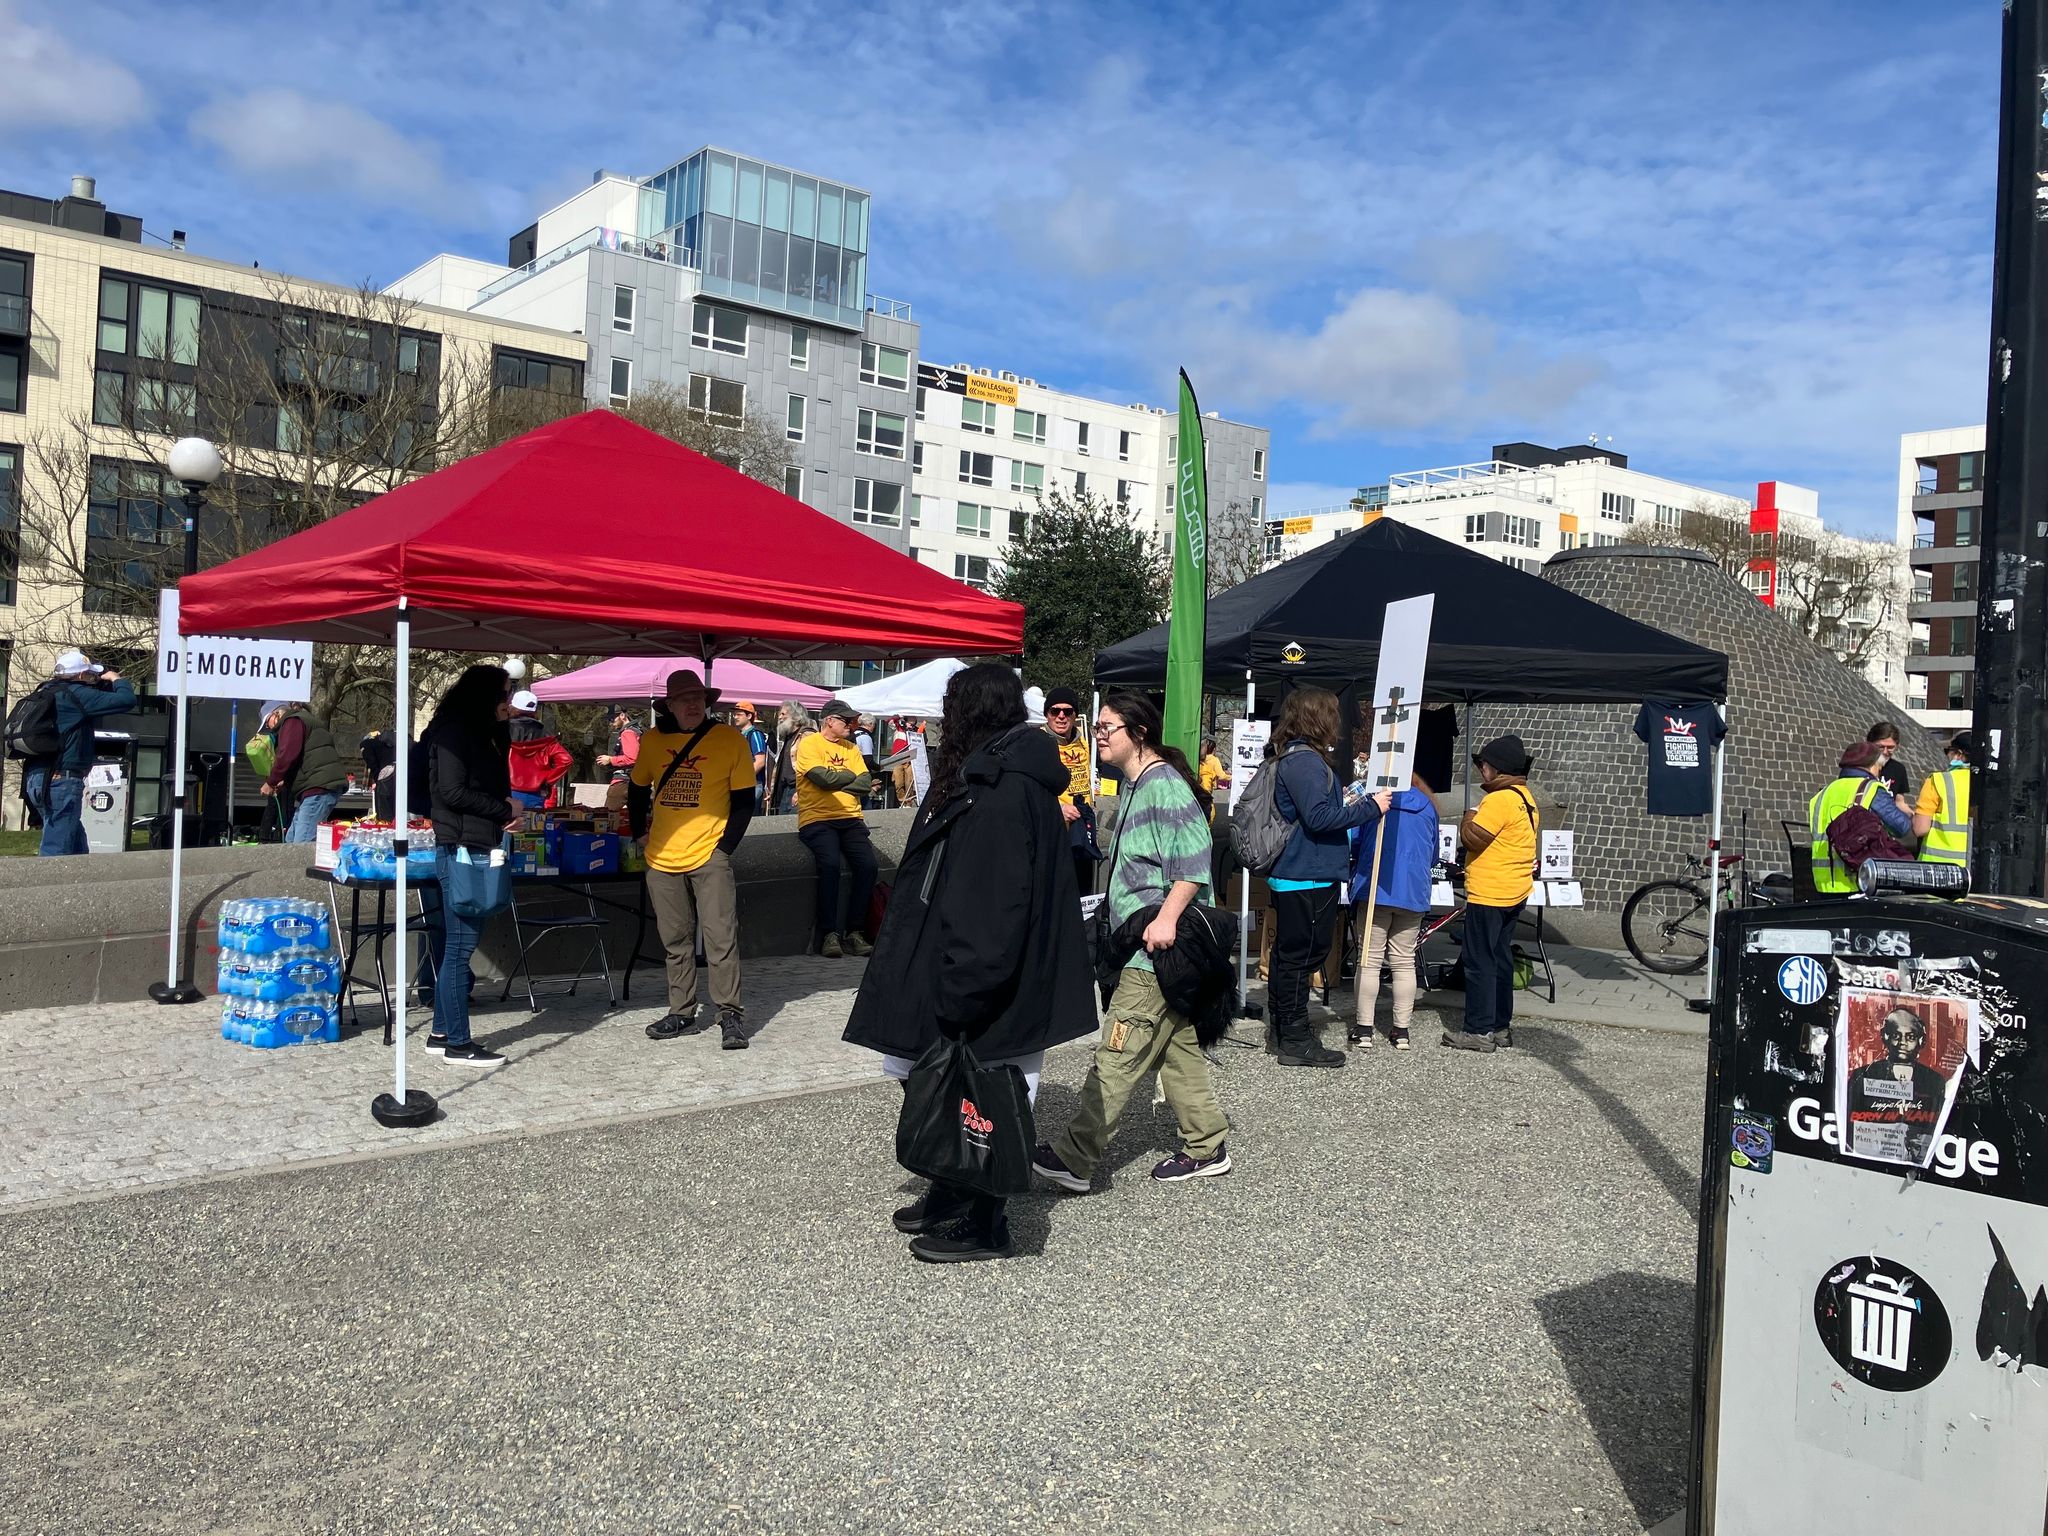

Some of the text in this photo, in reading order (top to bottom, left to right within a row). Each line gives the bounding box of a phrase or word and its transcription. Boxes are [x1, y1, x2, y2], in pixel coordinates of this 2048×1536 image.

[971, 379, 1014, 394] NOW LEASING!
[166, 650, 305, 680] DEMOCRACY
[1665, 742, 1698, 751] FIGHTING
[665, 780, 703, 789] IGHTING
[1879, 1082, 1897, 1090] DYKE
[1865, 1086, 1912, 1098] DISTRIBUTIONS
[1850, 1111, 1881, 1122] BORN
[1788, 1097, 1999, 1178] Gage
